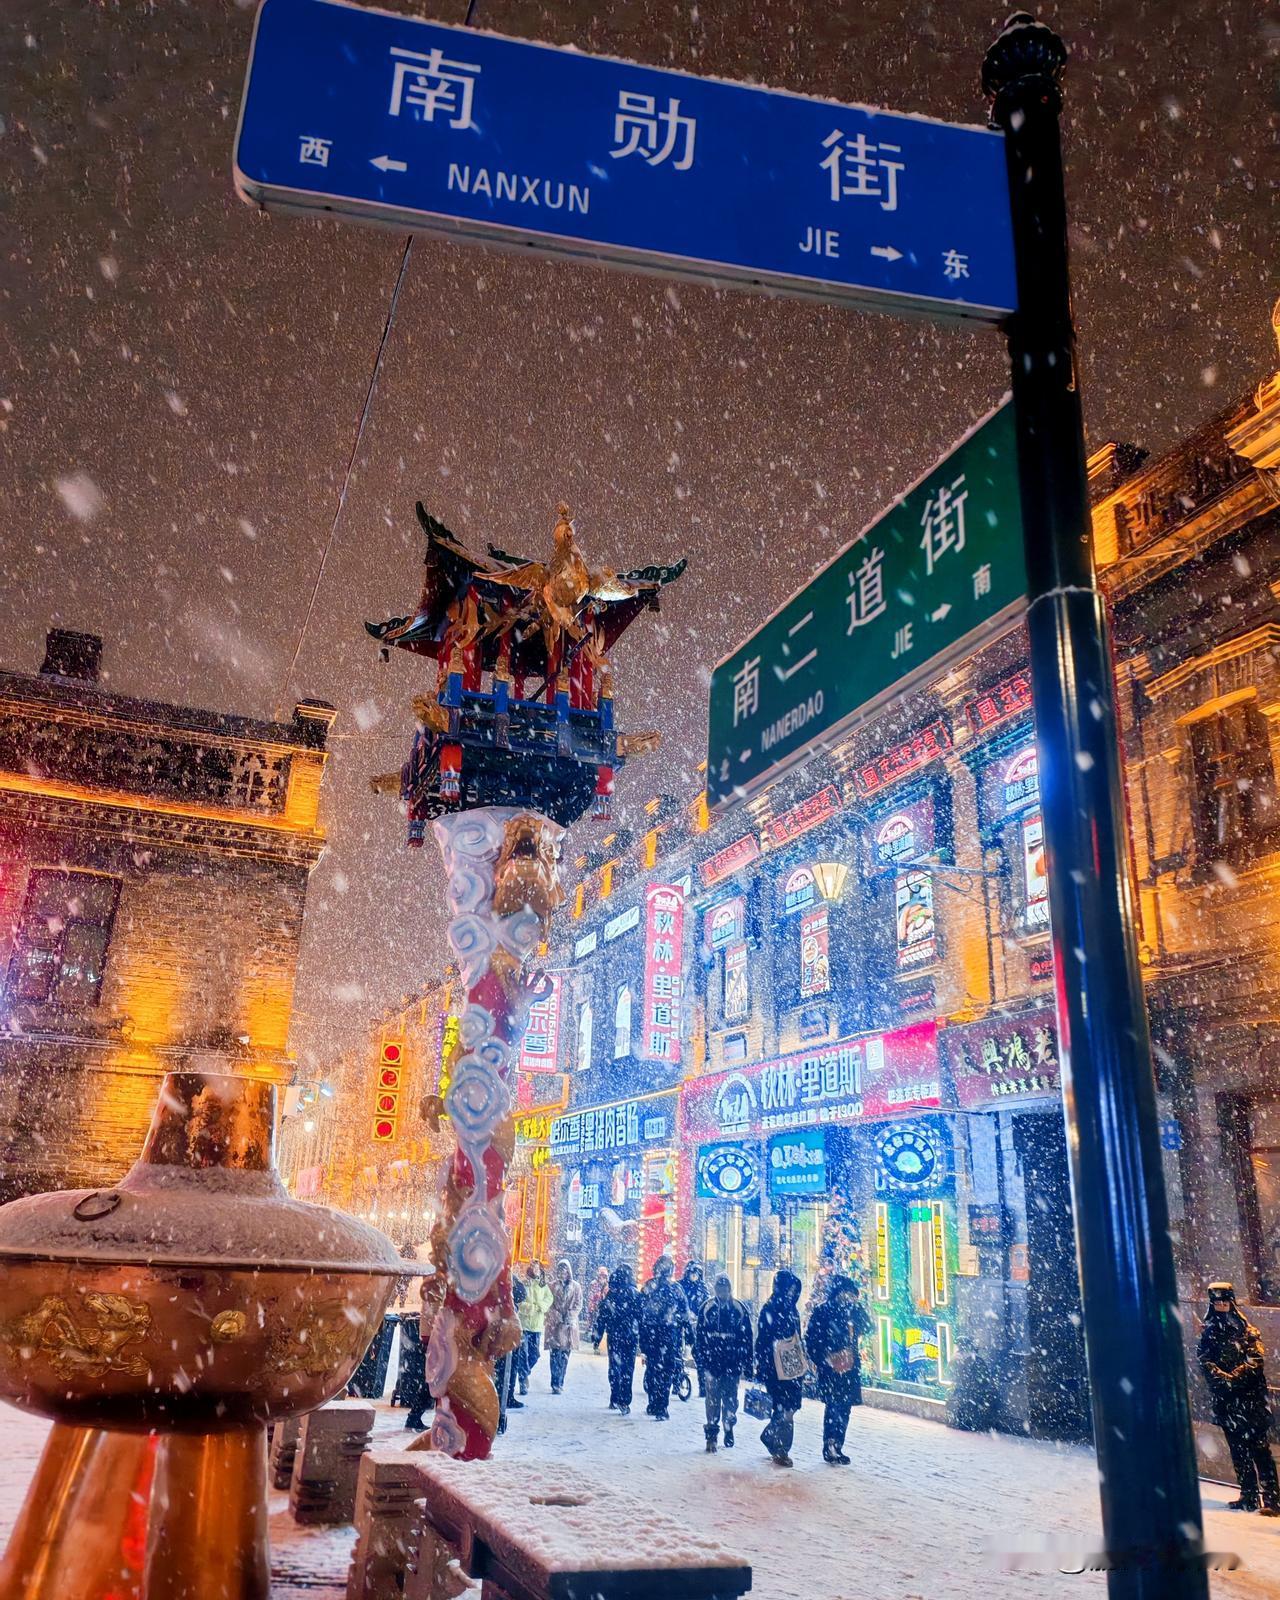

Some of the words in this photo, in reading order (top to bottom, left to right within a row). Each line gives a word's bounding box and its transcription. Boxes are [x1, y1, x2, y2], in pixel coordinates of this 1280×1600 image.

[300, 137, 332, 167] 西
[448, 163, 590, 214] NANXUN
[799, 227, 840, 258] JIE
[943, 249, 970, 279] 东
[389, 47, 905, 211] 南勋街
[733, 474, 969, 727] 南二道街
[760, 689, 825, 754] NANERDAO
[890, 622, 915, 660] JIE
[972, 563, 992, 601] 南
[760, 1045, 862, 1110] 秋林·里道斯
